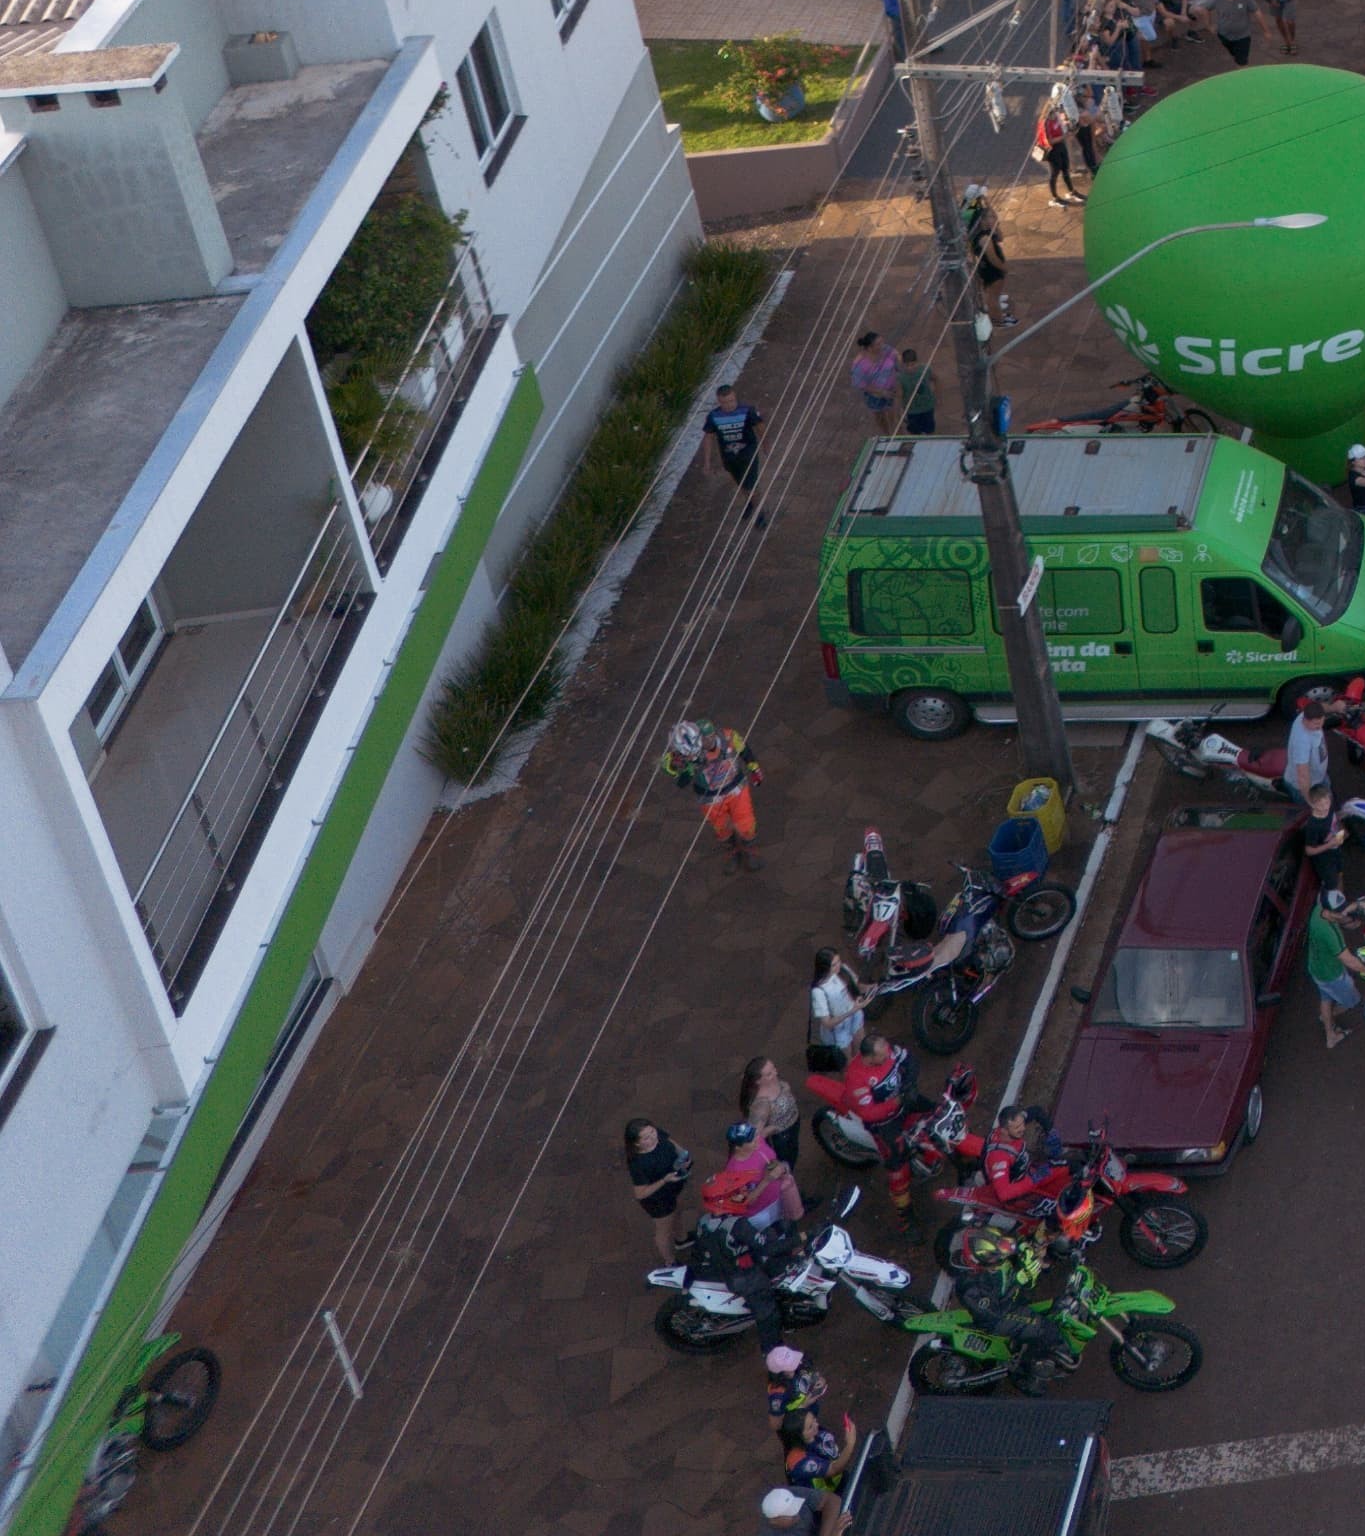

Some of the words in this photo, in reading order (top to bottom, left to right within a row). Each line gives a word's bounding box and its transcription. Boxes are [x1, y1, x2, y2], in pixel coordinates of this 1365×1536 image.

[1056, 607, 1089, 617] com
[1080, 641, 1110, 657] da
[1246, 650, 1298, 663] Sicredi
